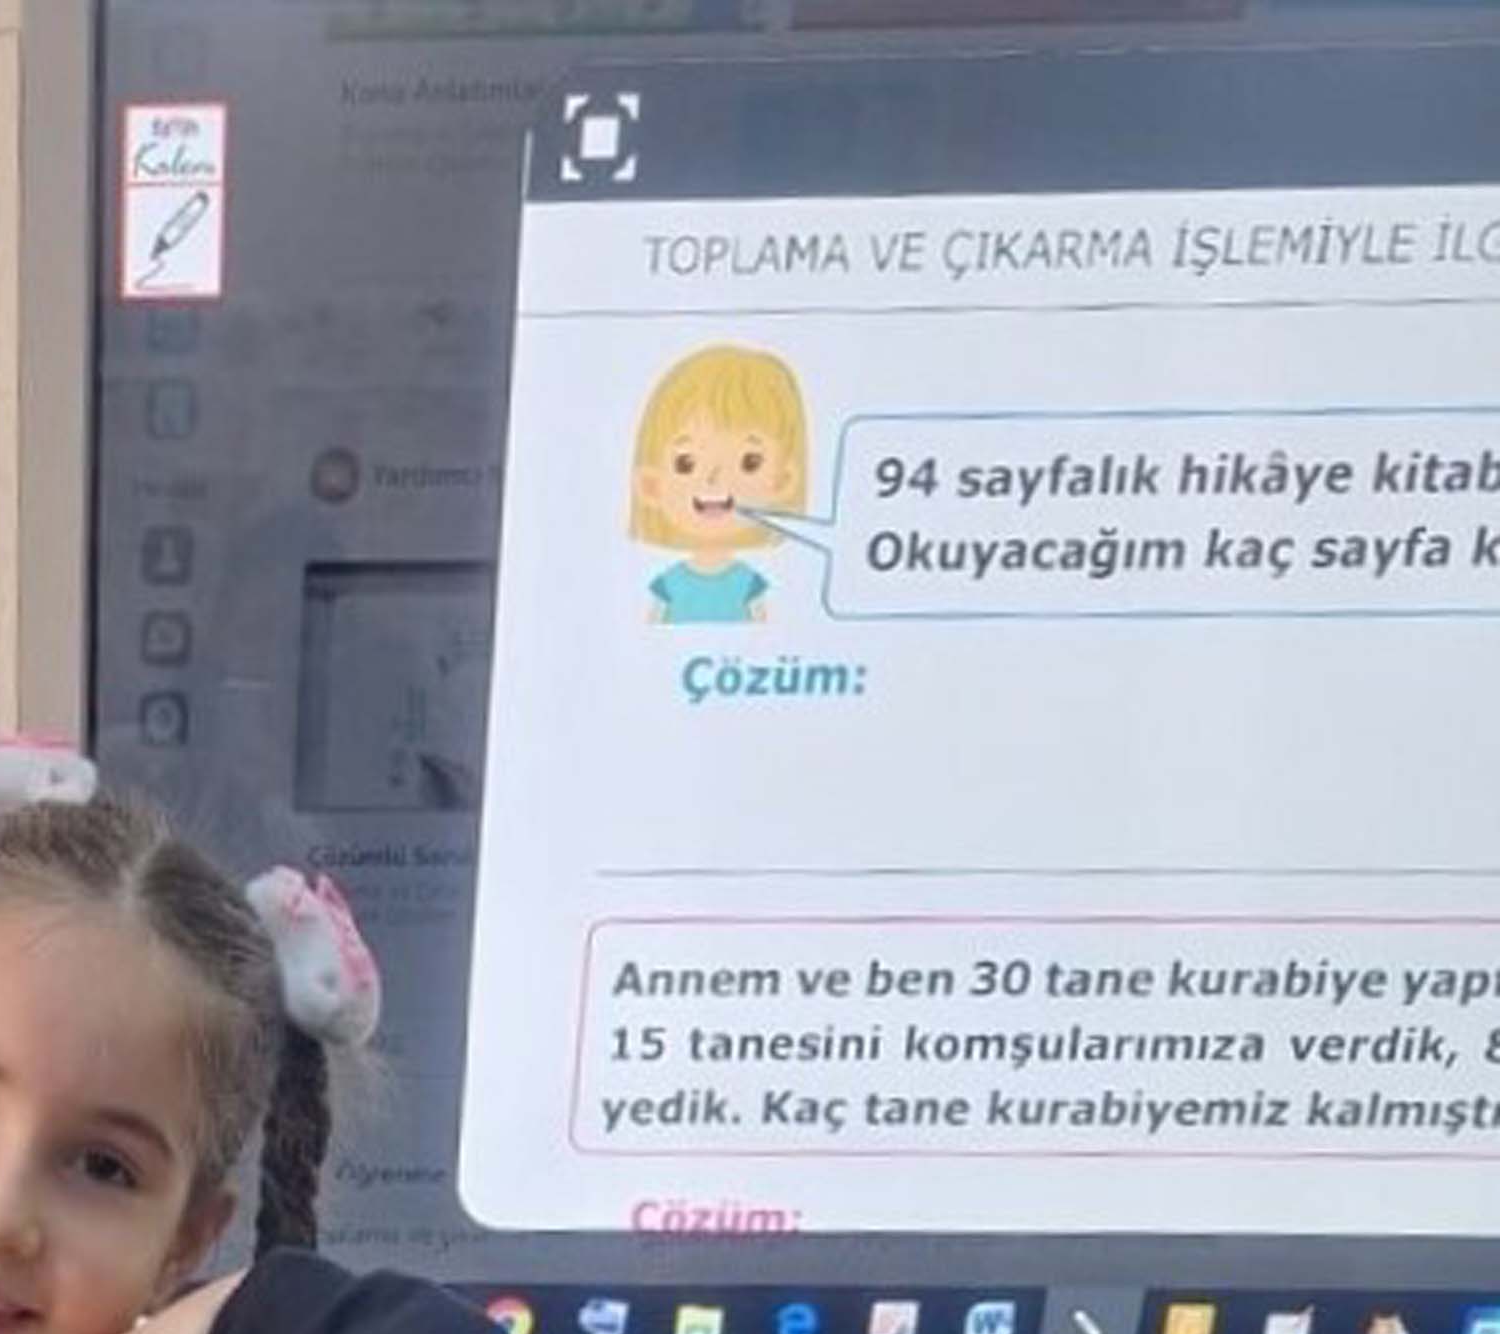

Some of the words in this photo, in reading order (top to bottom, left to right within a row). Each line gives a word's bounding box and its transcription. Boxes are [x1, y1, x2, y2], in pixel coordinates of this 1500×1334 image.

[645, 233, 852, 277] TOPLAMA
[871, 231, 925, 273] VE
[942, 227, 1153, 281] ÇIKARMA
[1171, 216, 1418, 276] İŞLEMİYLE
[876, 456, 940, 497] 94
[957, 454, 1161, 509] sayfalık
[1179, 446, 1354, 508] hikâye
[866, 527, 1186, 580] Okuyacağım
[1205, 530, 1296, 578] kaç
[1311, 524, 1452, 579] sayfa
[681, 655, 868, 706] Çözüm:
[613, 960, 781, 999] Annem
[796, 966, 852, 999] ve
[866, 961, 955, 999] ben
[969, 960, 1033, 998] 30
[1045, 962, 1154, 999] tane
[1170, 958, 1389, 1006] kurabiye
[609, 1026, 668, 1063] 15
[688, 1025, 882, 1064] tanesini
[903, 1024, 1266, 1070] komşularımıza
[1290, 1026, 1457, 1069] verdik,
[601, 1089, 743, 1134] yedik.
[760, 1091, 848, 1134] Kaç
[864, 1092, 970, 1129] tane
[986, 1089, 1291, 1134] kurabiyemiz
